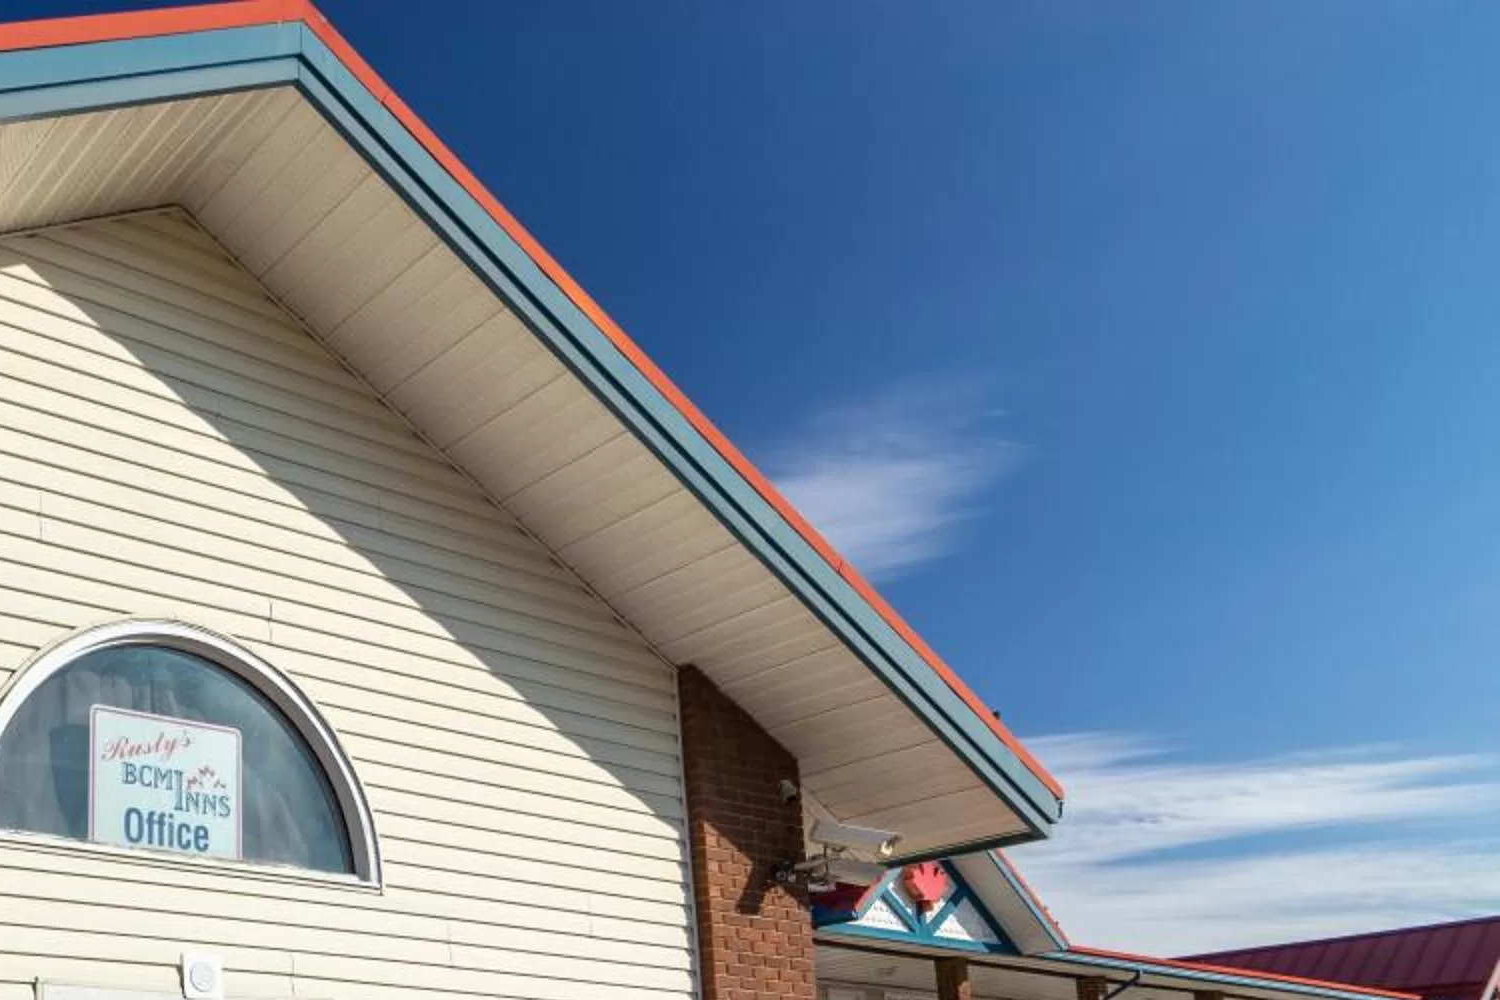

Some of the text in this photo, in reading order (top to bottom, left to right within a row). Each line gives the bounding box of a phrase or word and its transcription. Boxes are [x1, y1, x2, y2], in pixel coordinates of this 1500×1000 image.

[121, 761, 232, 819] BCM INNS
[124, 807, 209, 852] Office
